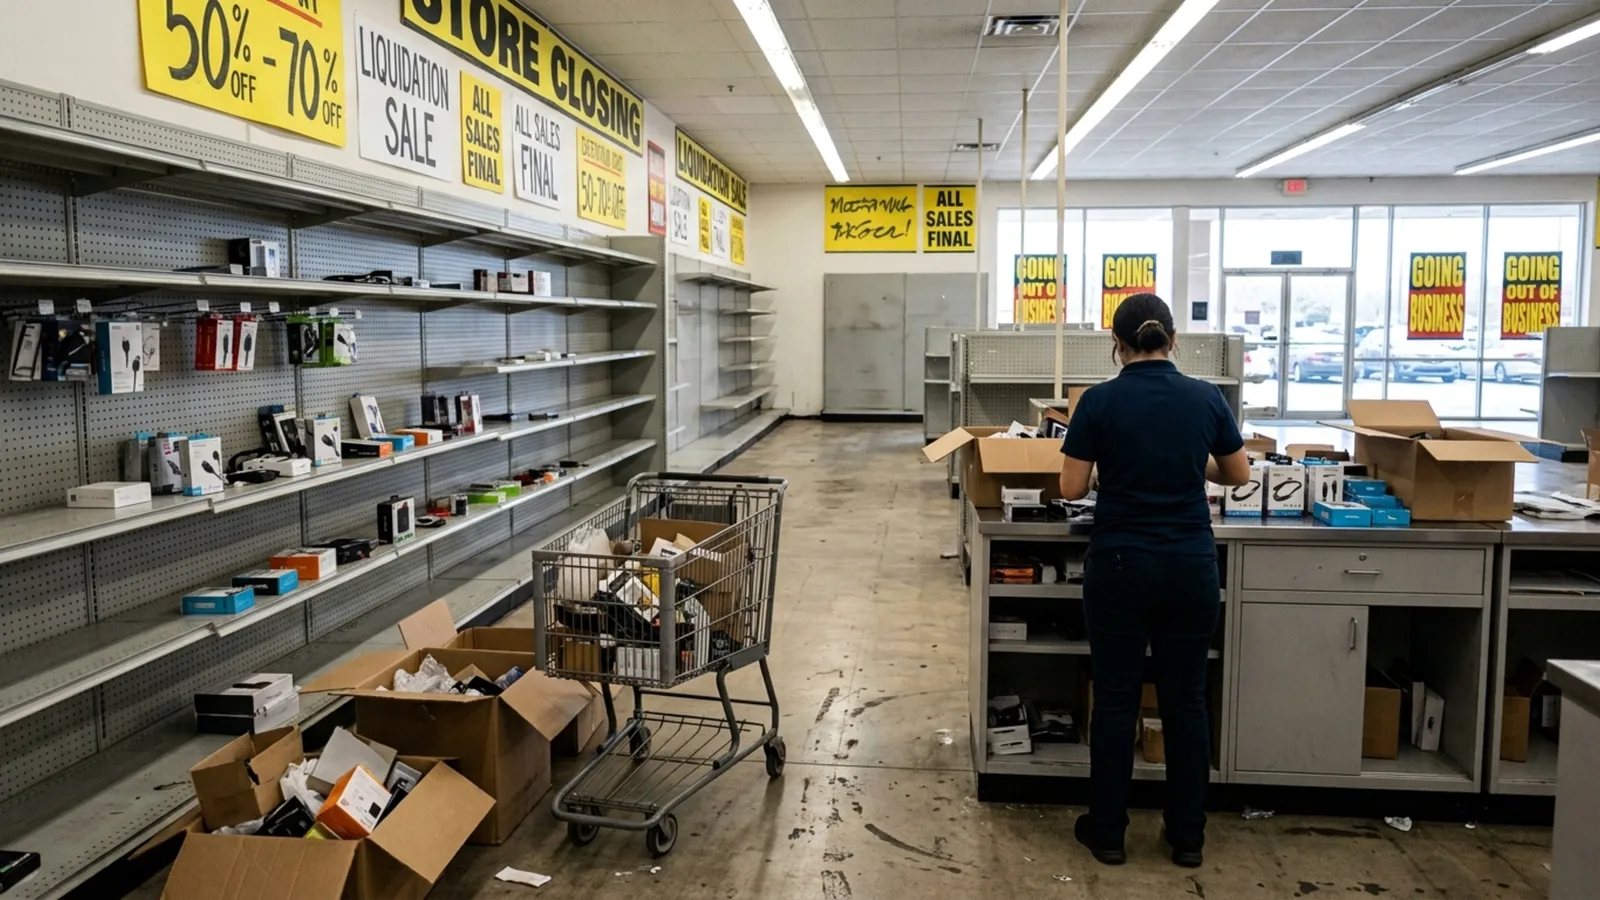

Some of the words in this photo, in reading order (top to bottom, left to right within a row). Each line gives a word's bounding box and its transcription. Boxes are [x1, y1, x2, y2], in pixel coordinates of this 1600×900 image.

[359, 26, 449, 111] LIQUIDATION
[231, 70, 257, 103] OFF
[473, 85, 493, 118] ALL
[551, 45, 640, 148] CLOSING
[322, 100, 342, 129] OFF
[514, 104, 532, 139] ALL
[534, 113, 561, 151] SALES
[385, 96, 437, 168] SALE
[465, 115, 500, 154] SALES
[467, 150, 500, 185] FINAL
[521, 143, 558, 201] FINAL
[936, 190, 963, 207] ALL
[926, 210, 973, 227] SALES
[928, 230, 972, 247] FINAL
[1104, 256, 1154, 288] GOING
[1412, 255, 1464, 288] GOING
[1505, 255, 1560, 281] GOING
[1506, 284, 1537, 299] OUT
[1539, 284, 1559, 299] OF
[1409, 293, 1464, 333] BUSINESS
